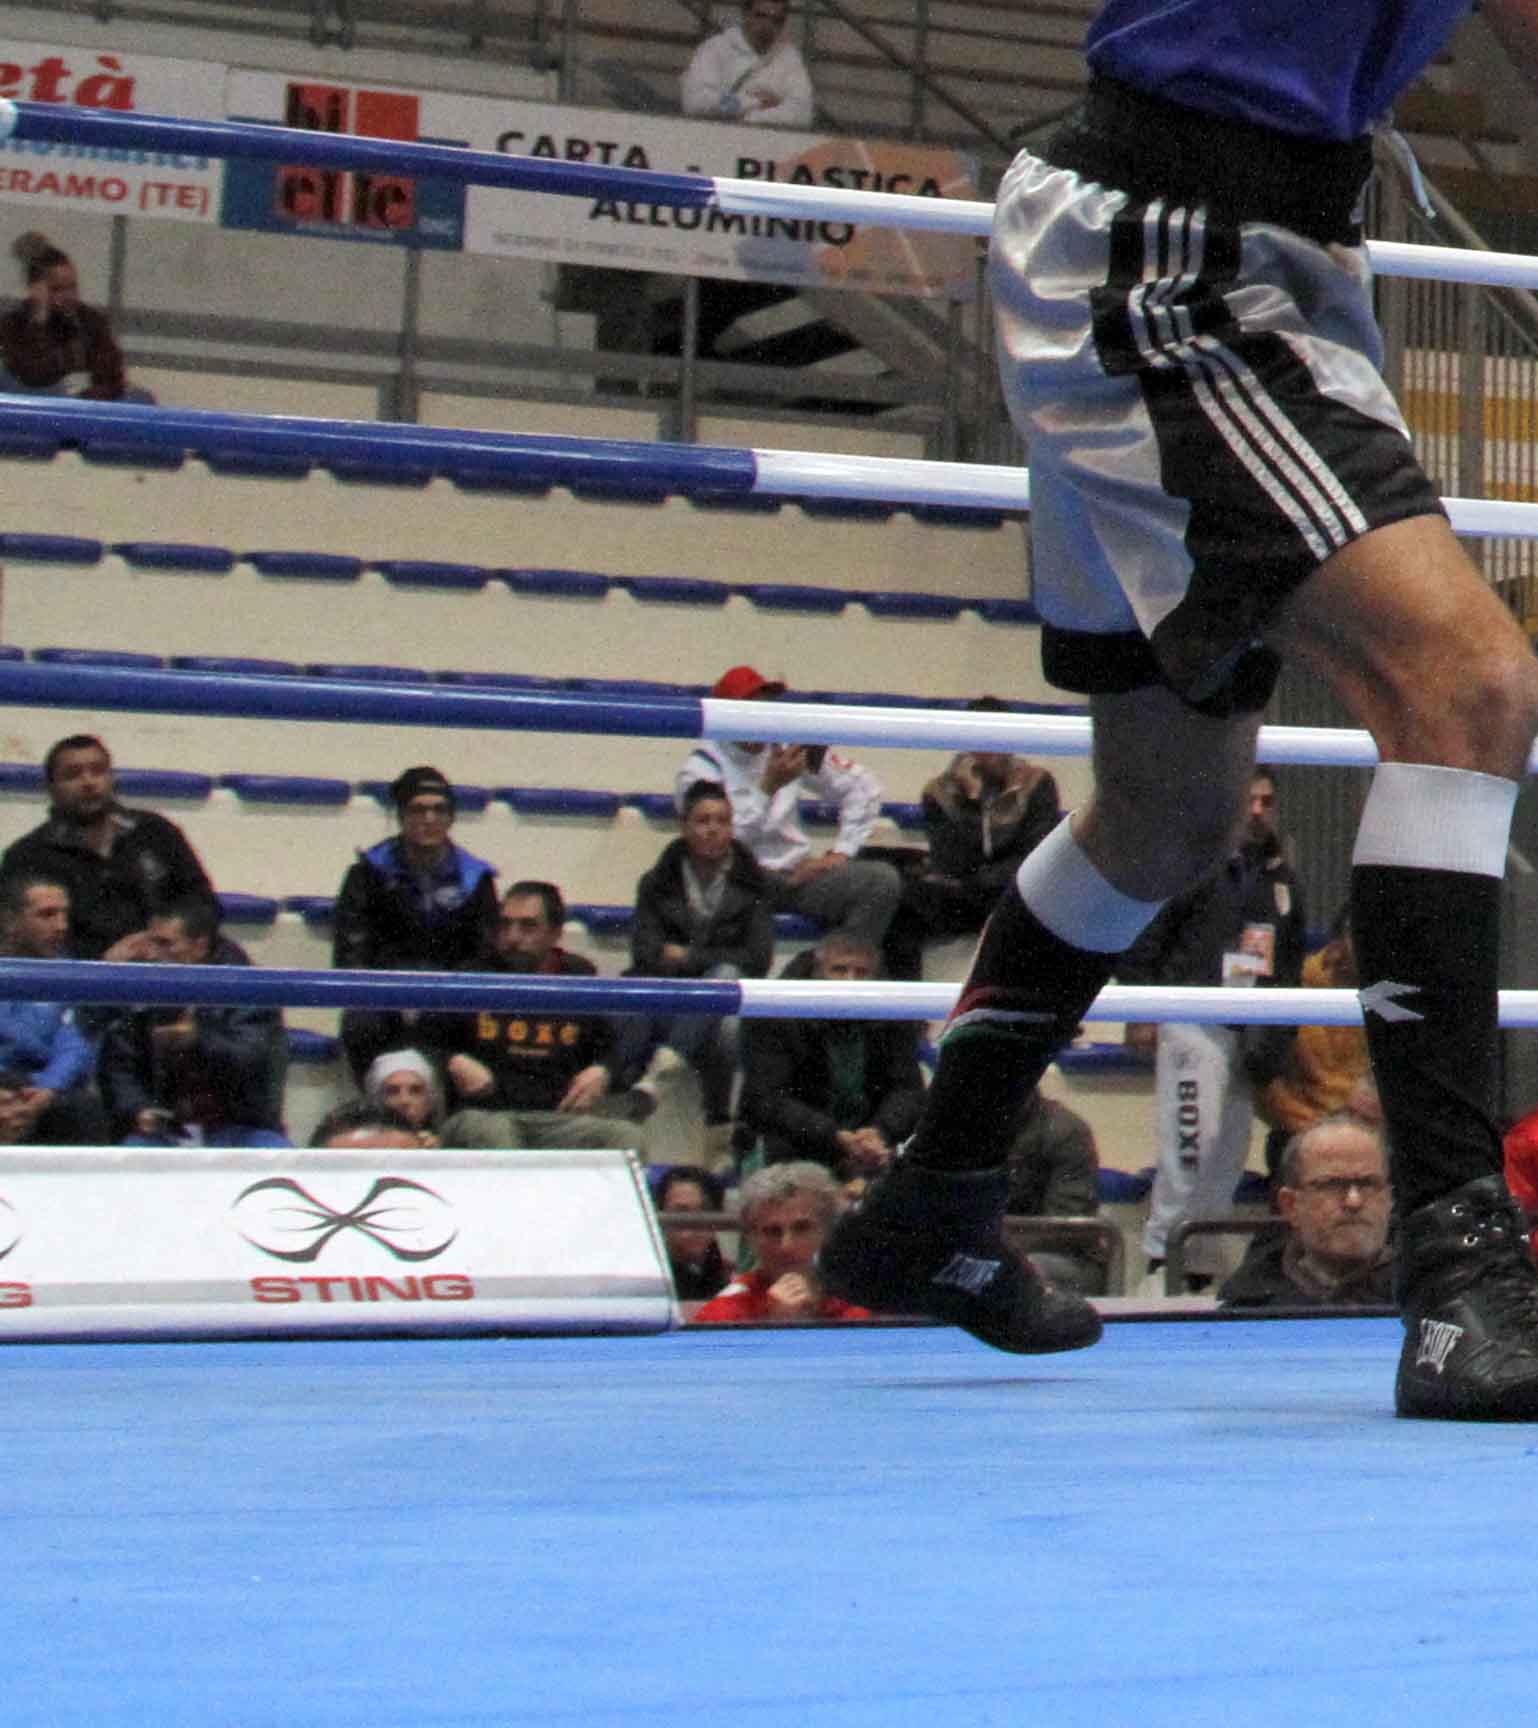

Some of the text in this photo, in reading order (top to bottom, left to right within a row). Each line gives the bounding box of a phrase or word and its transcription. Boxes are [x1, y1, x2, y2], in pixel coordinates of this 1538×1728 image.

[496, 131, 651, 169] CARTA
[0, 168, 129, 203] RAMO
[588, 198, 855, 246] ALLUMINIO
[249, 1274, 475, 1304] STING
